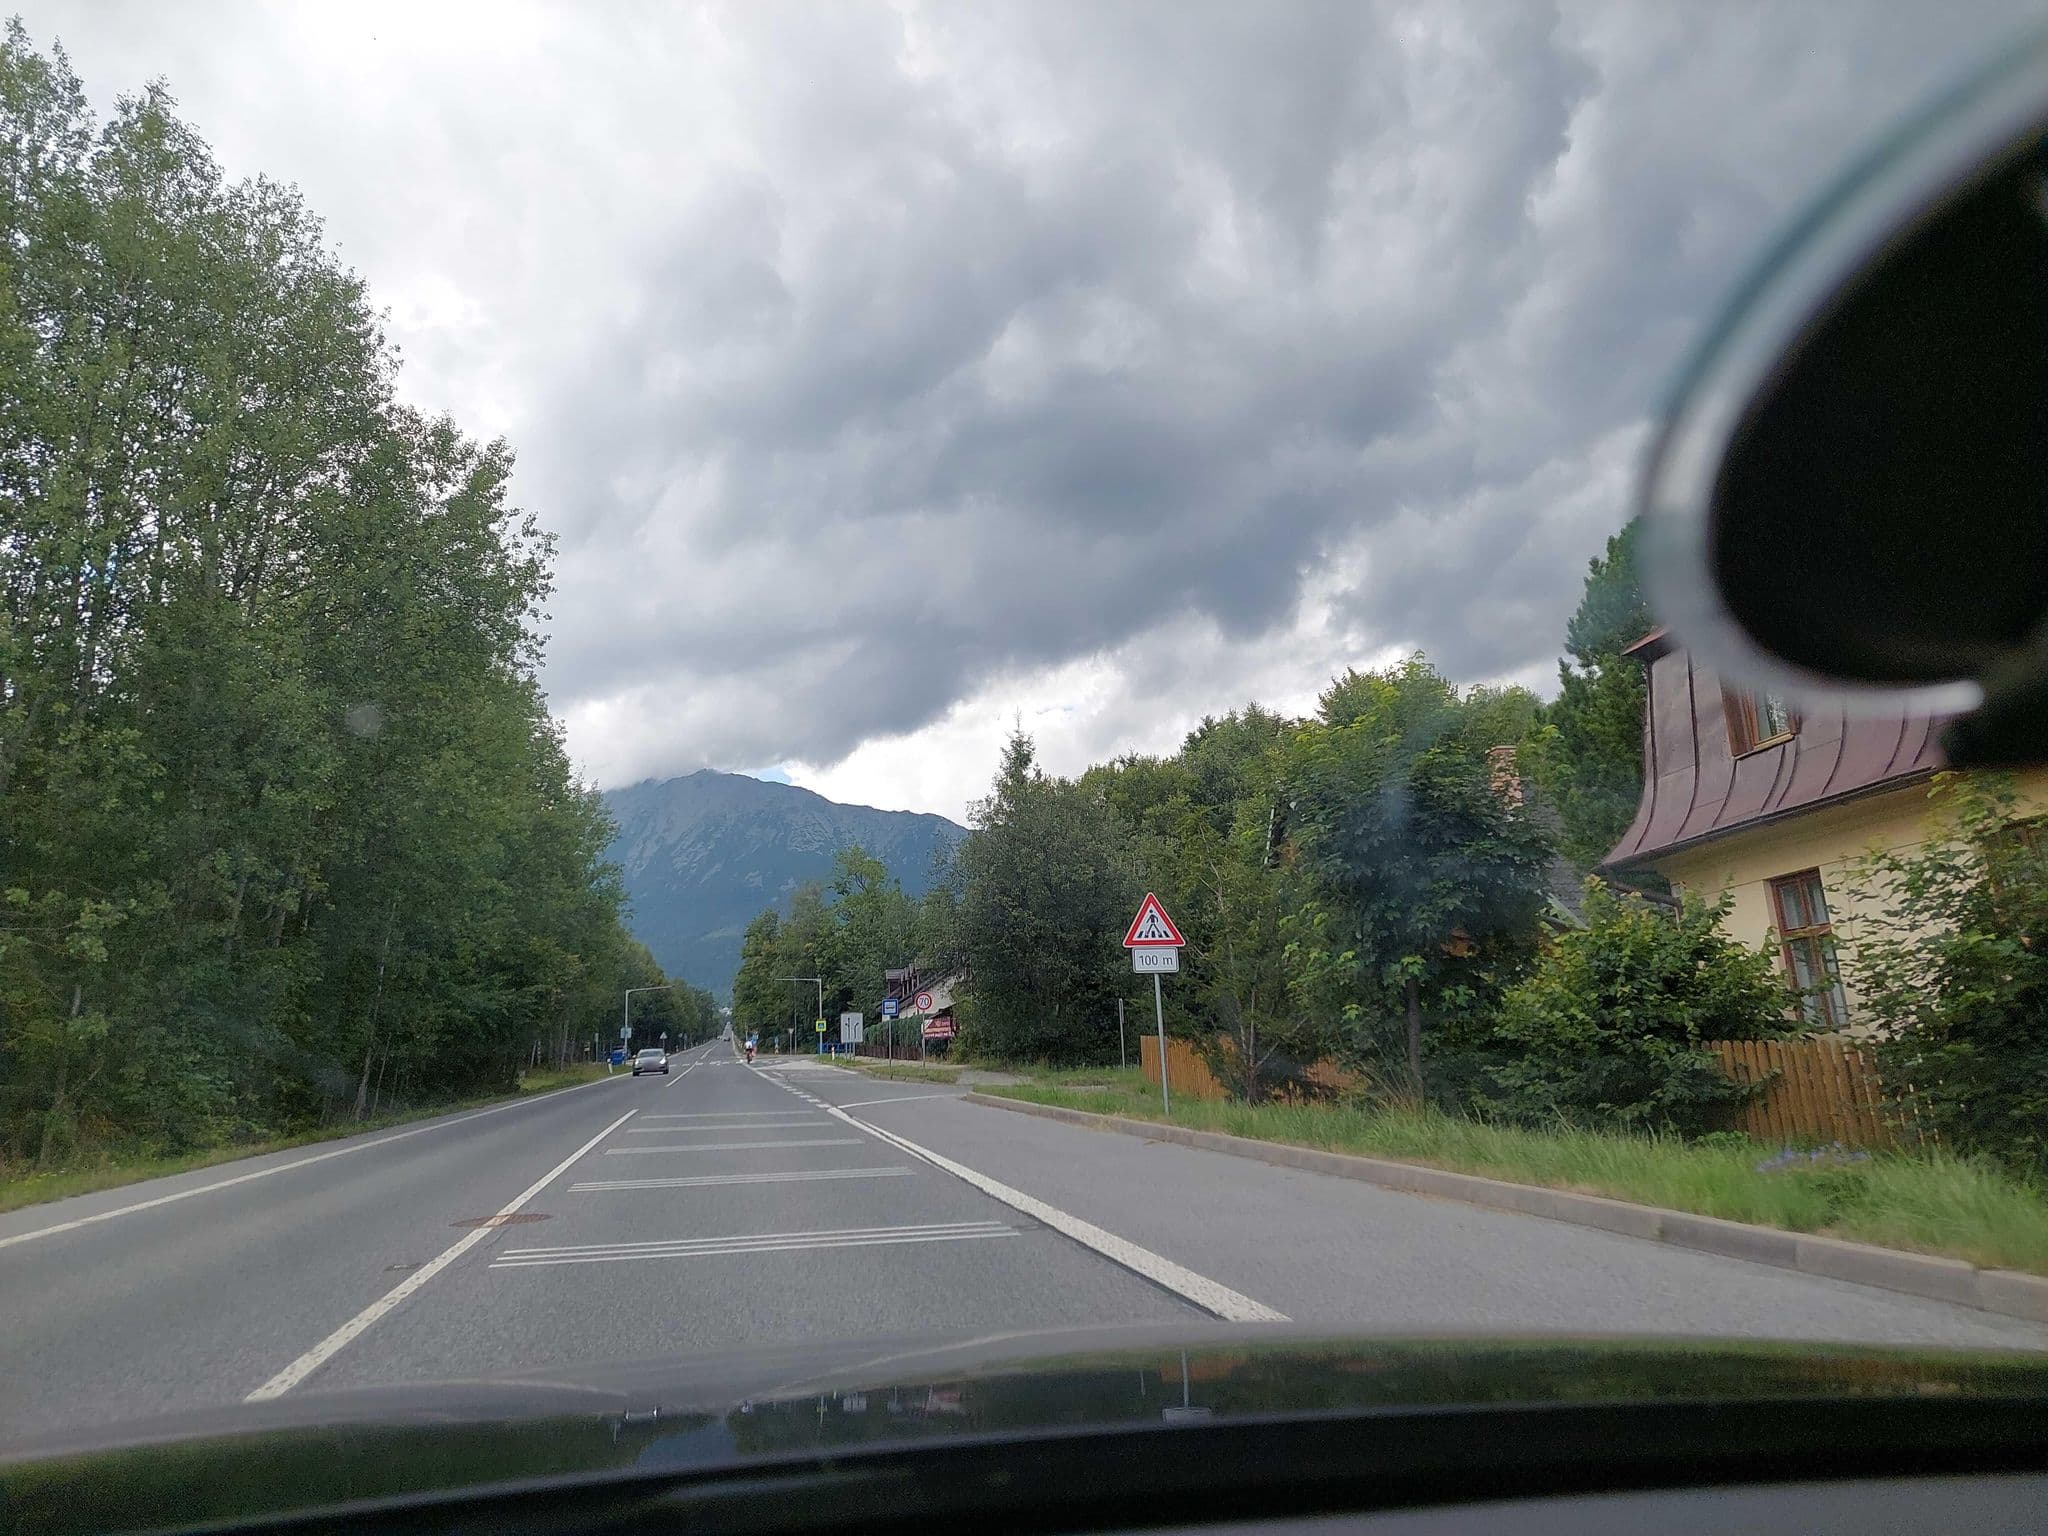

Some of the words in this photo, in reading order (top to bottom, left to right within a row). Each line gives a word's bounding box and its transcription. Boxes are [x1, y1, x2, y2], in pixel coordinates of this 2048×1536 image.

[1138, 954, 1158, 966] 100
[1162, 956, 1173, 965] m
[918, 997, 930, 1007] 70
